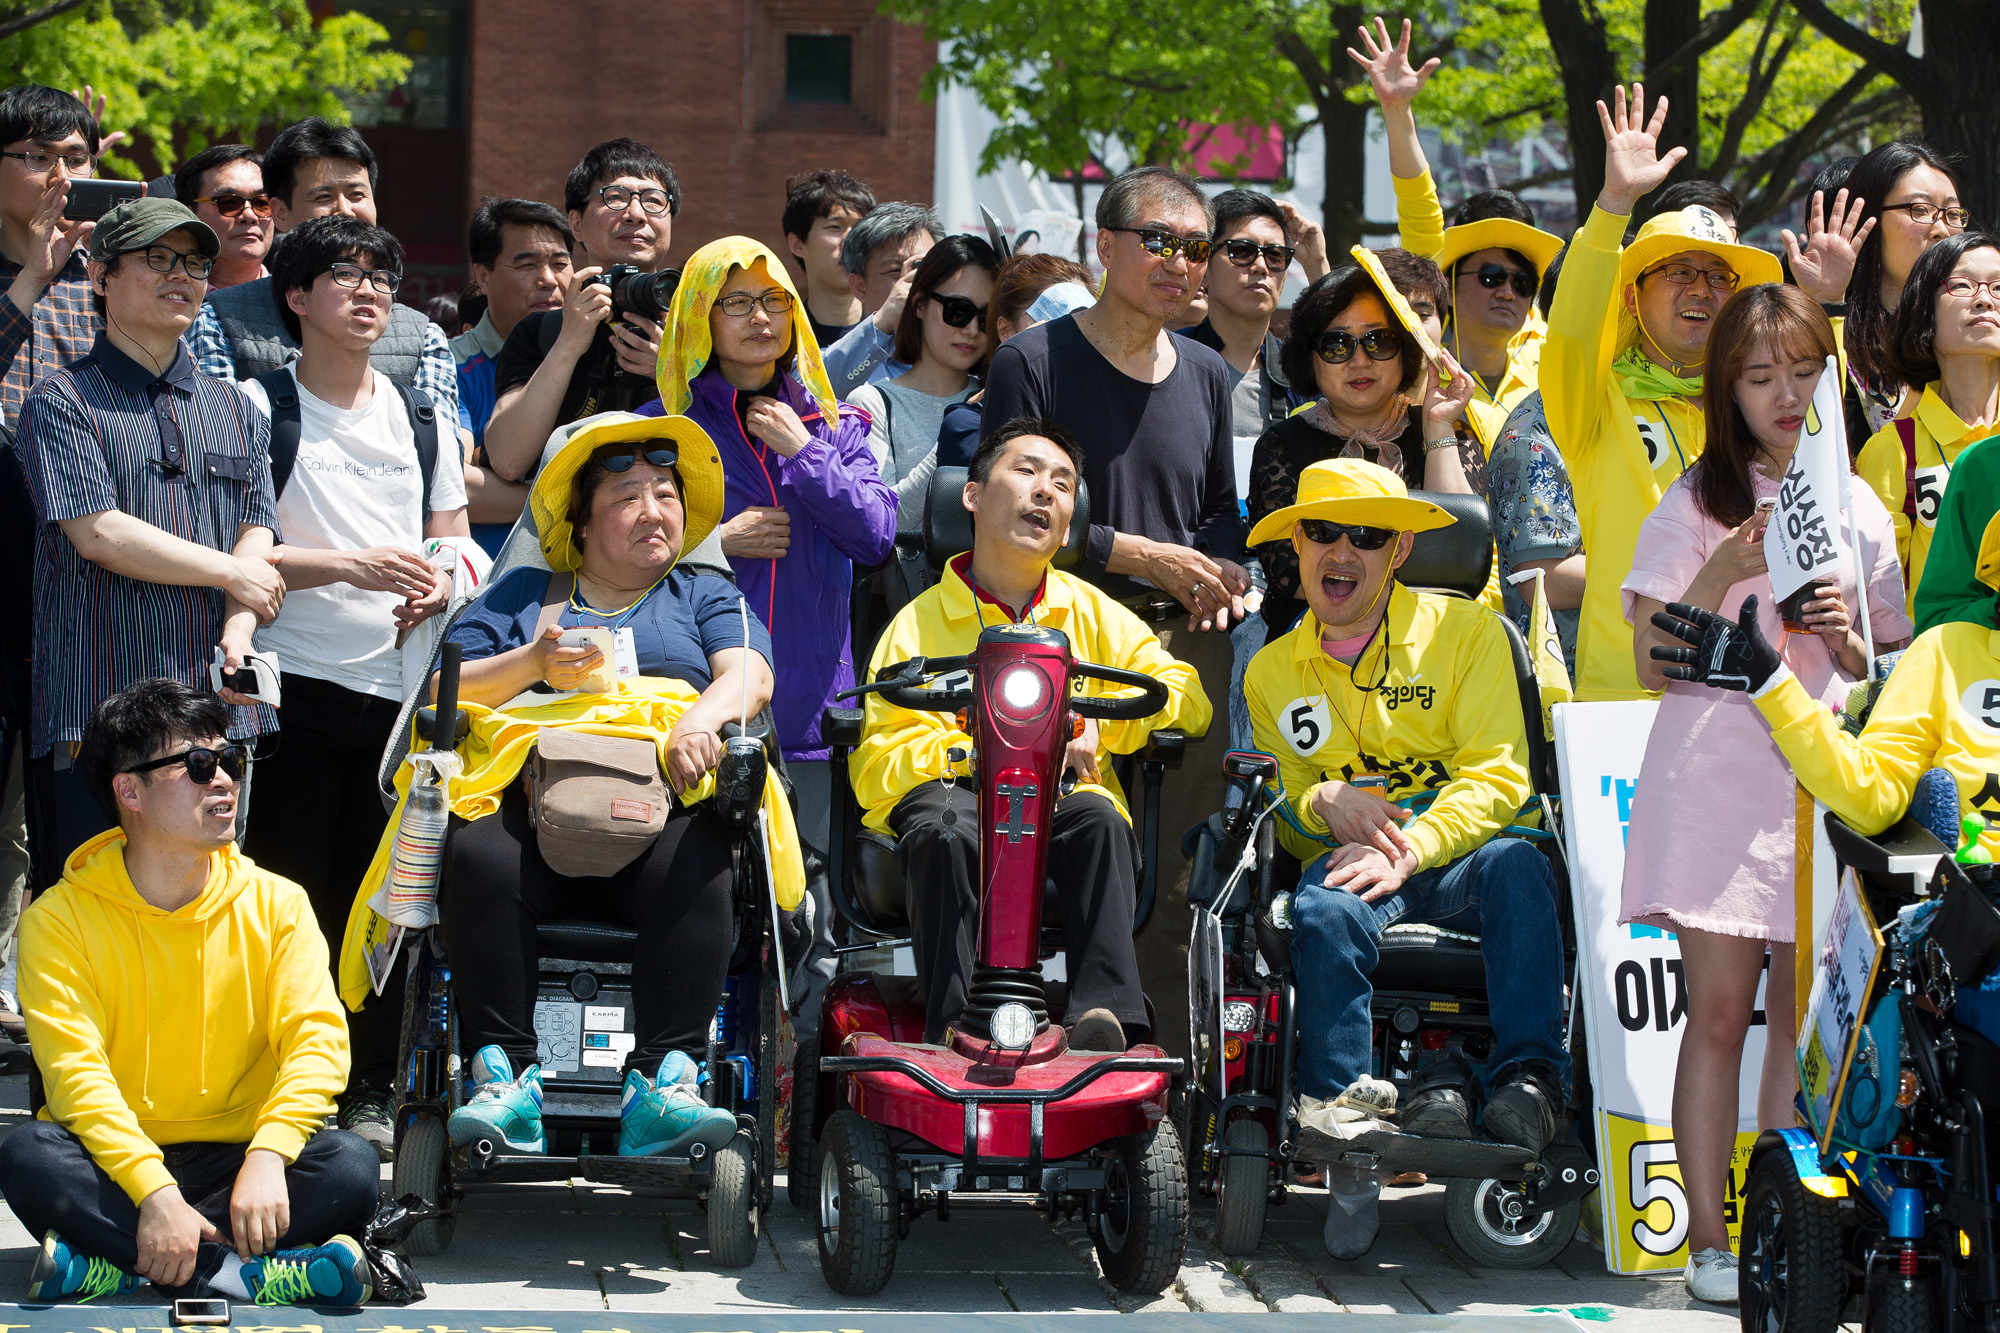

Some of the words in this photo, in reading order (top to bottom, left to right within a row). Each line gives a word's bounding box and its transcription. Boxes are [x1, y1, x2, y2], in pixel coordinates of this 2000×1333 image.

[1700, 209, 1715, 228] 5
[300, 456, 342, 473] Calvin
[344, 461, 377, 477] Klein
[378, 462, 415, 477] Jeans
[1915, 474, 1943, 521] 5
[1779, 469, 1838, 572] 심상정
[1379, 685, 1436, 711] 정의당
[1291, 705, 1320, 750] 5
[1629, 1139, 1690, 1256] 5
